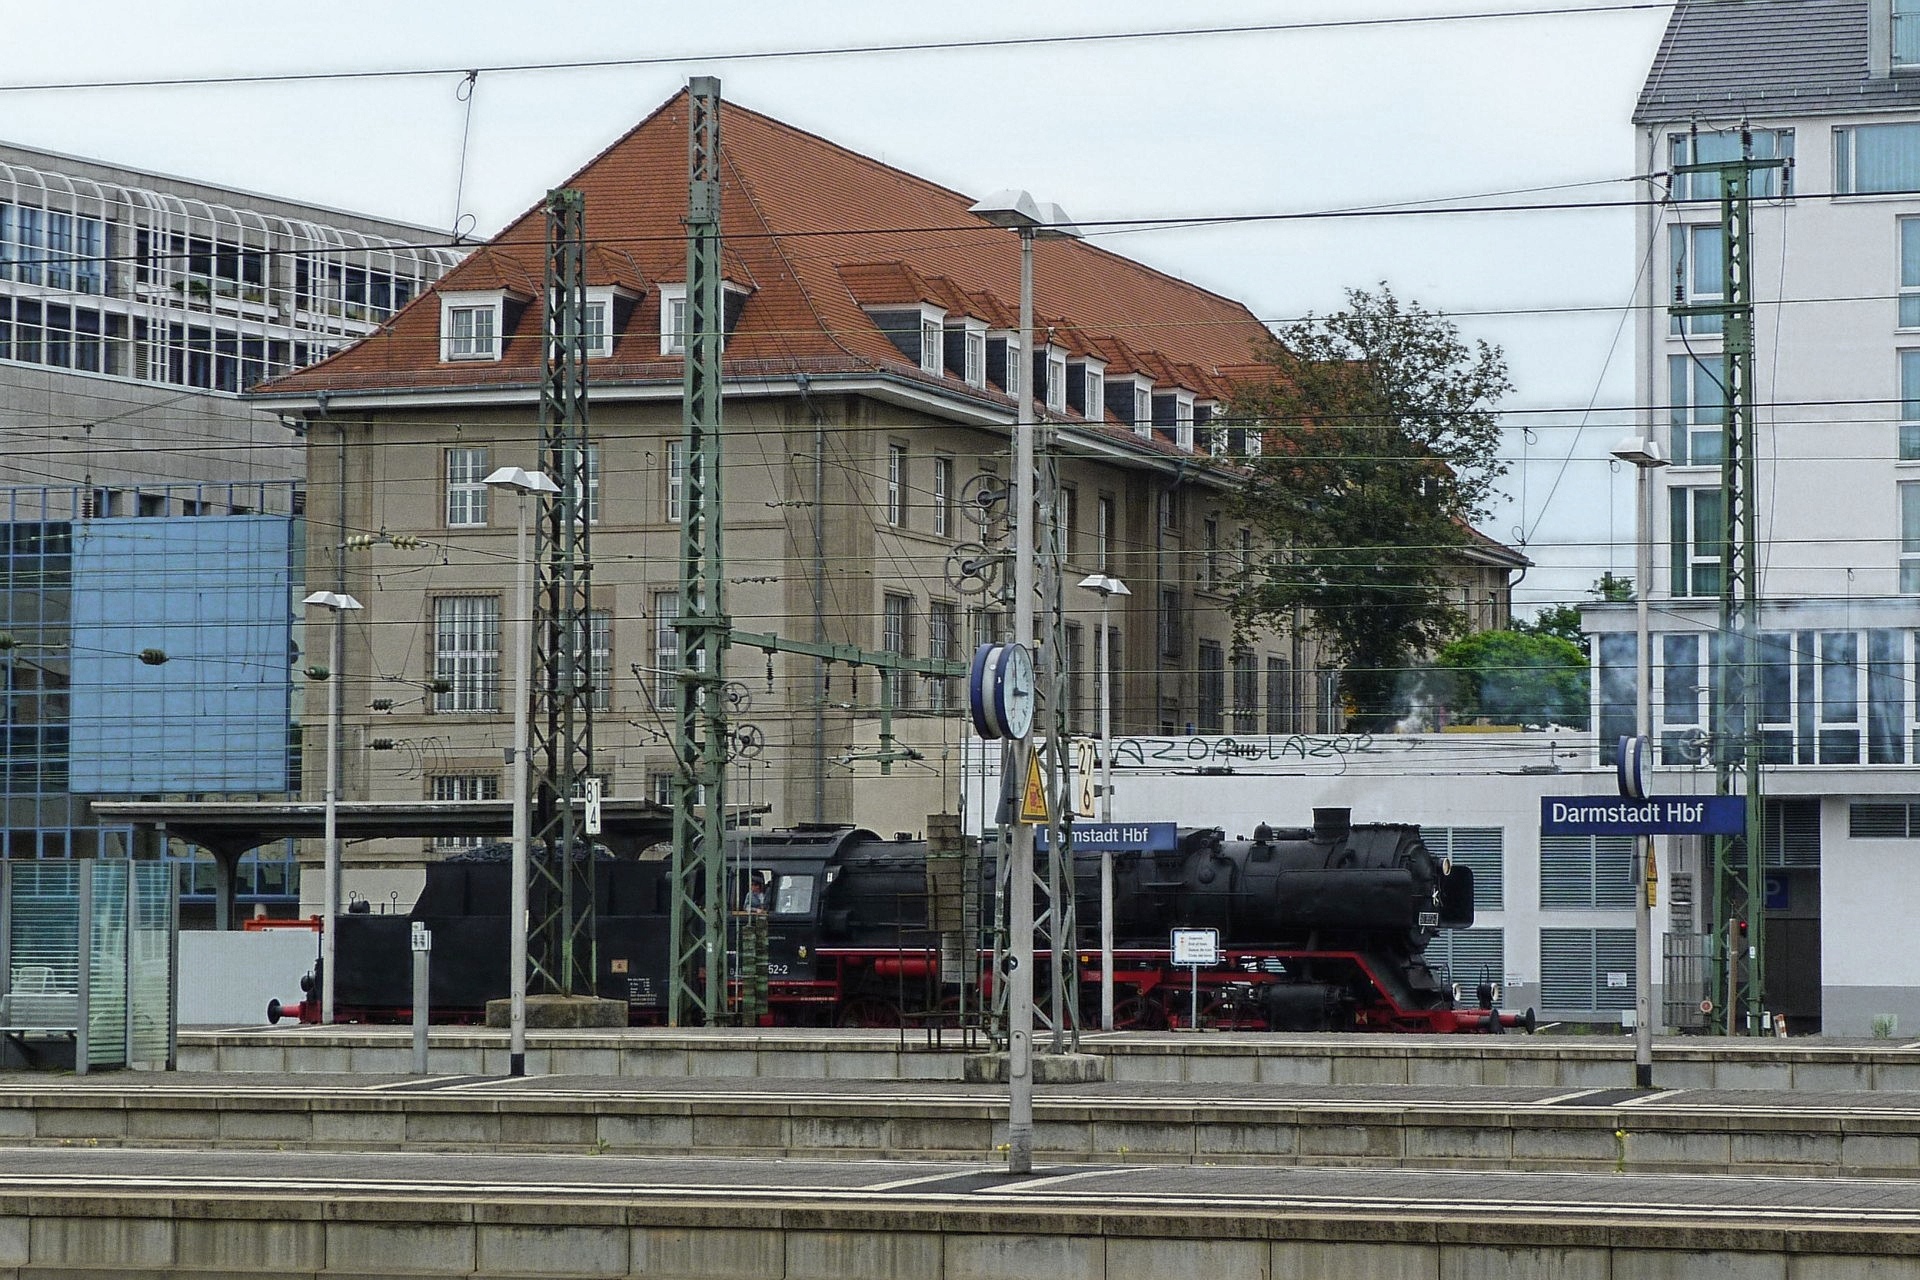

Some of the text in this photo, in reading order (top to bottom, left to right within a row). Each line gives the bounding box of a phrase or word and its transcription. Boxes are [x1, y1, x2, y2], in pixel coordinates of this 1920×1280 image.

[1079, 743, 1092, 776] 27
[586, 781, 599, 804] 81
[1083, 779, 1091, 810] 6
[590, 806, 597, 828] 4
[1552, 803, 1704, 823] Darmstadt Hbf
[1122, 827, 1149, 843] Hbf
